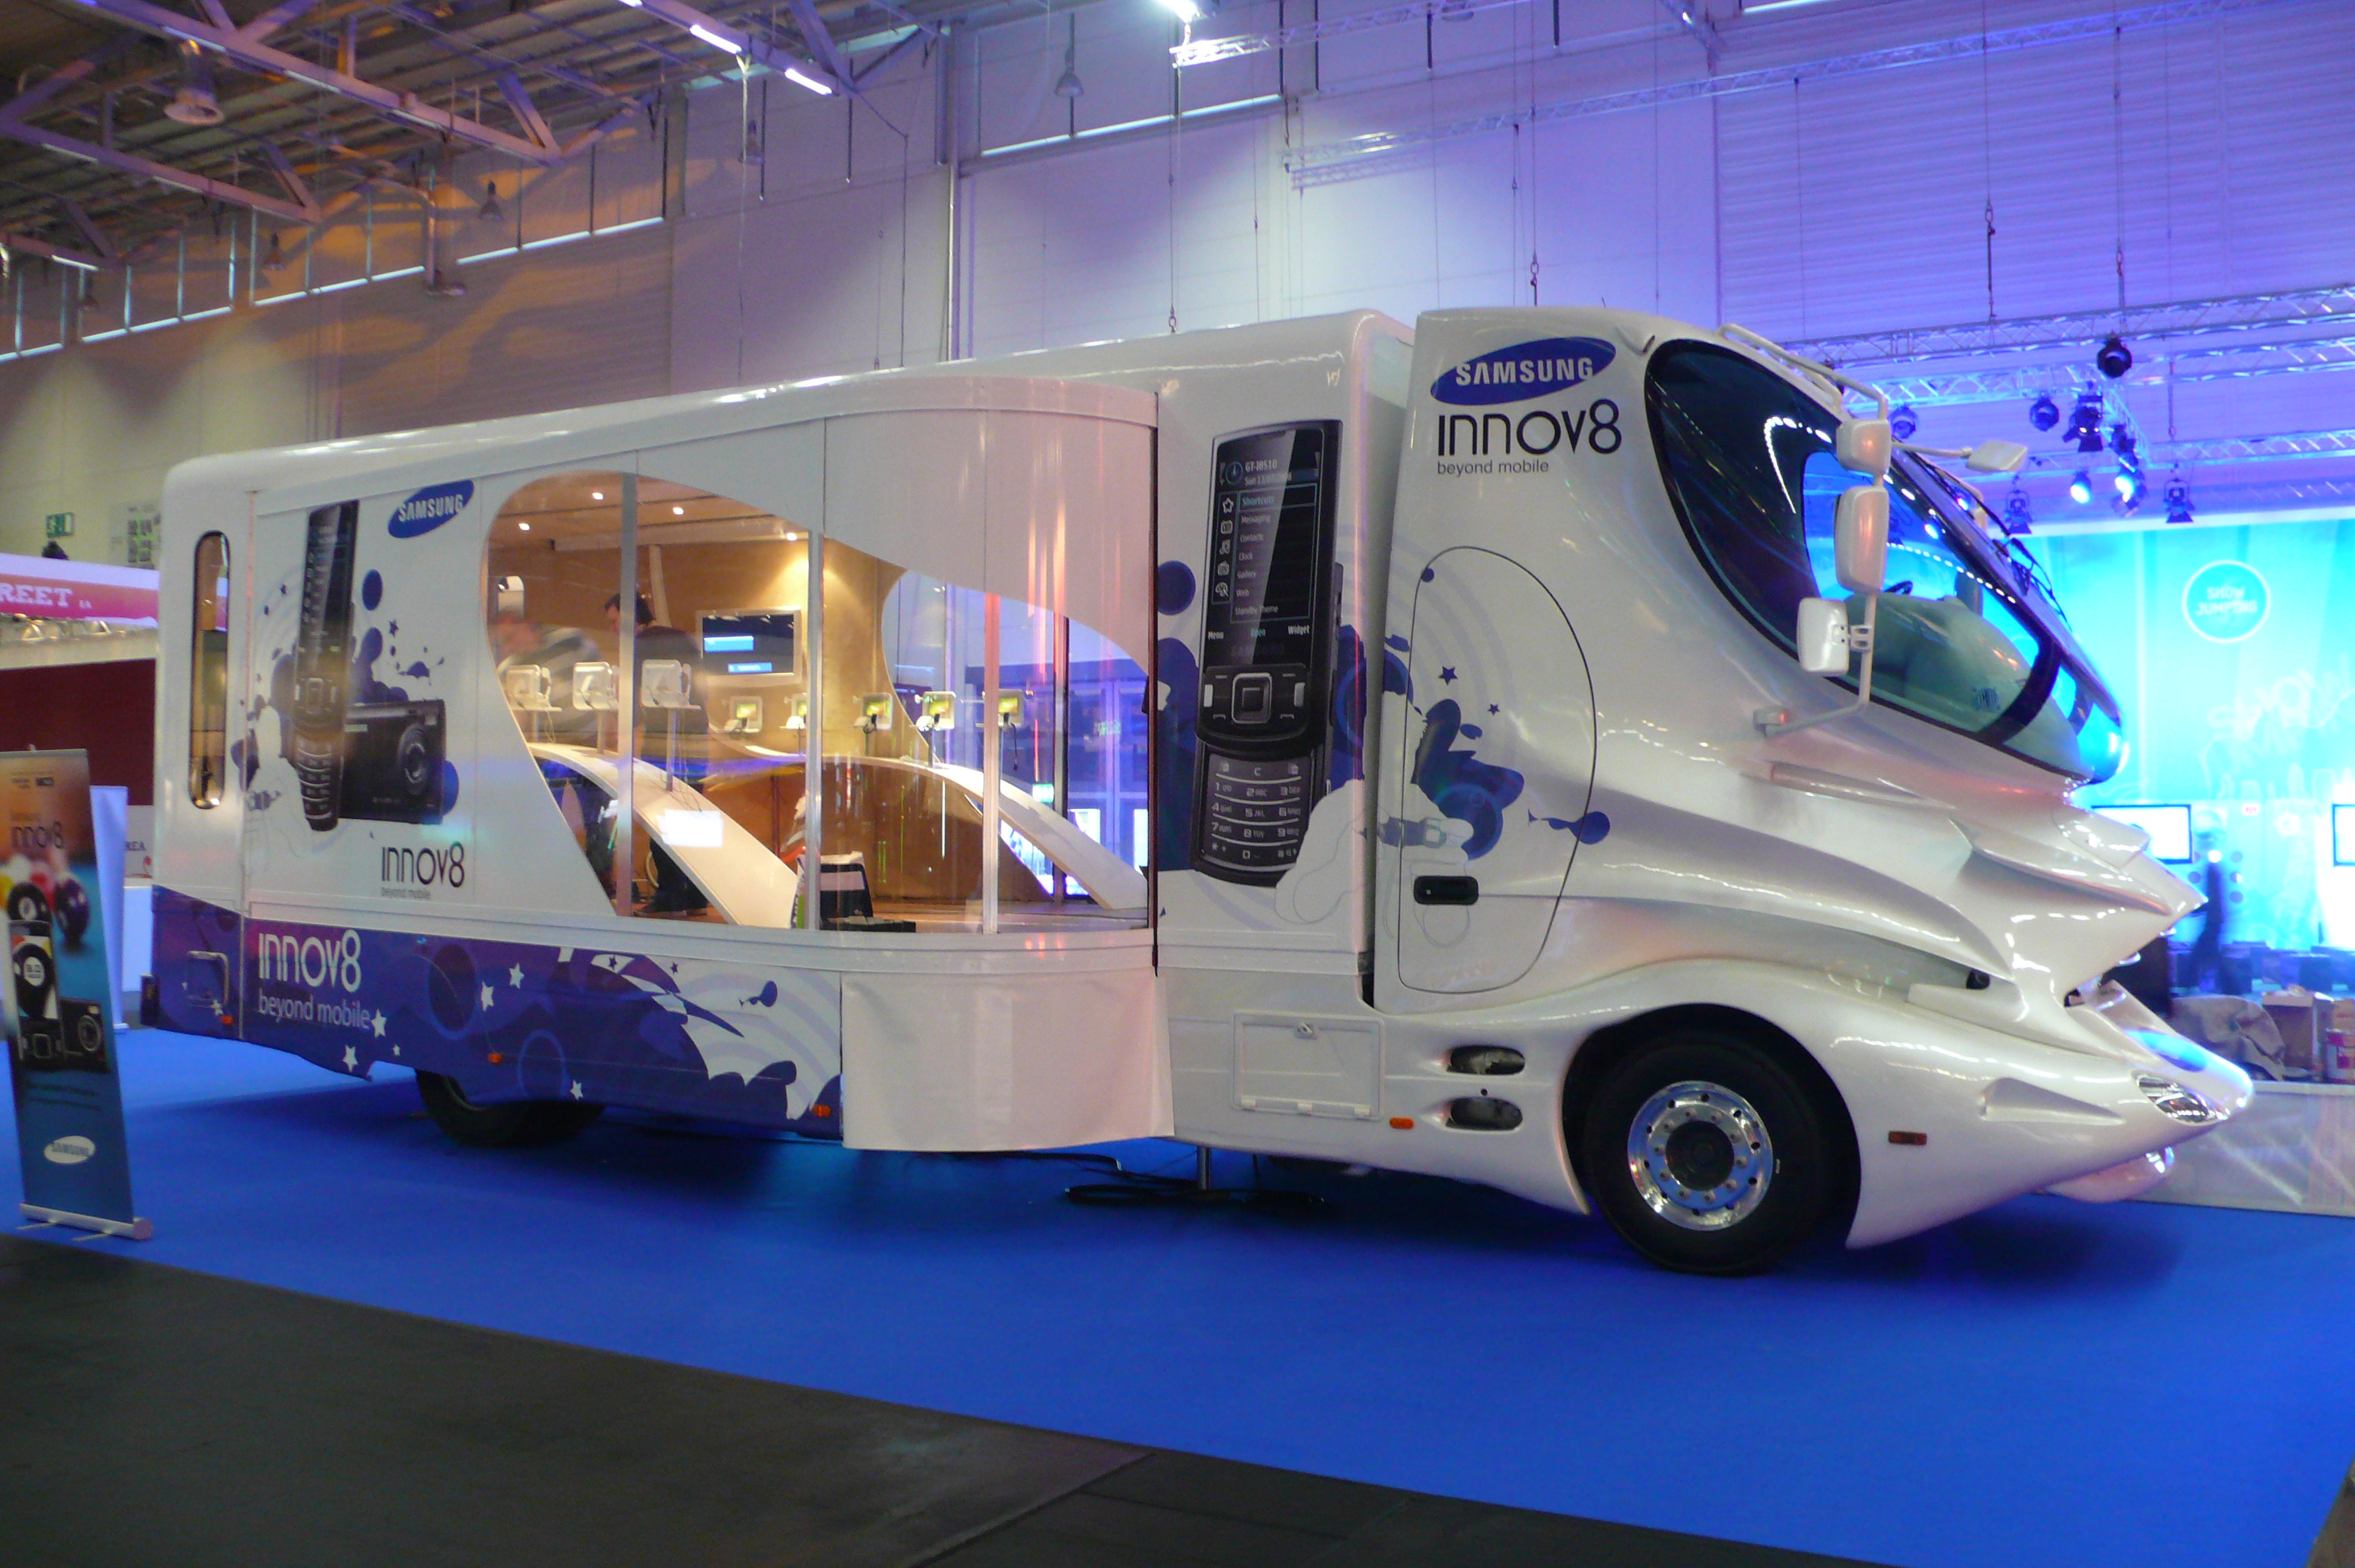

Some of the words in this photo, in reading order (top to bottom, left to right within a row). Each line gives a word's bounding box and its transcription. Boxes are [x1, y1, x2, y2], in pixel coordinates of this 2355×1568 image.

[1455, 357, 1594, 386] SAMSUNG
[1438, 459, 1493, 478] beyond
[1498, 459, 1549, 473] mobile
[398, 493, 464, 523] SAMSUNG
[2206, 587, 2246, 601] SHOW
[2195, 600, 2258, 616] JUMPING
[1288, 624, 1310, 636] Widget
[258, 987, 314, 1023] beyond
[317, 998, 370, 1029] mobile
